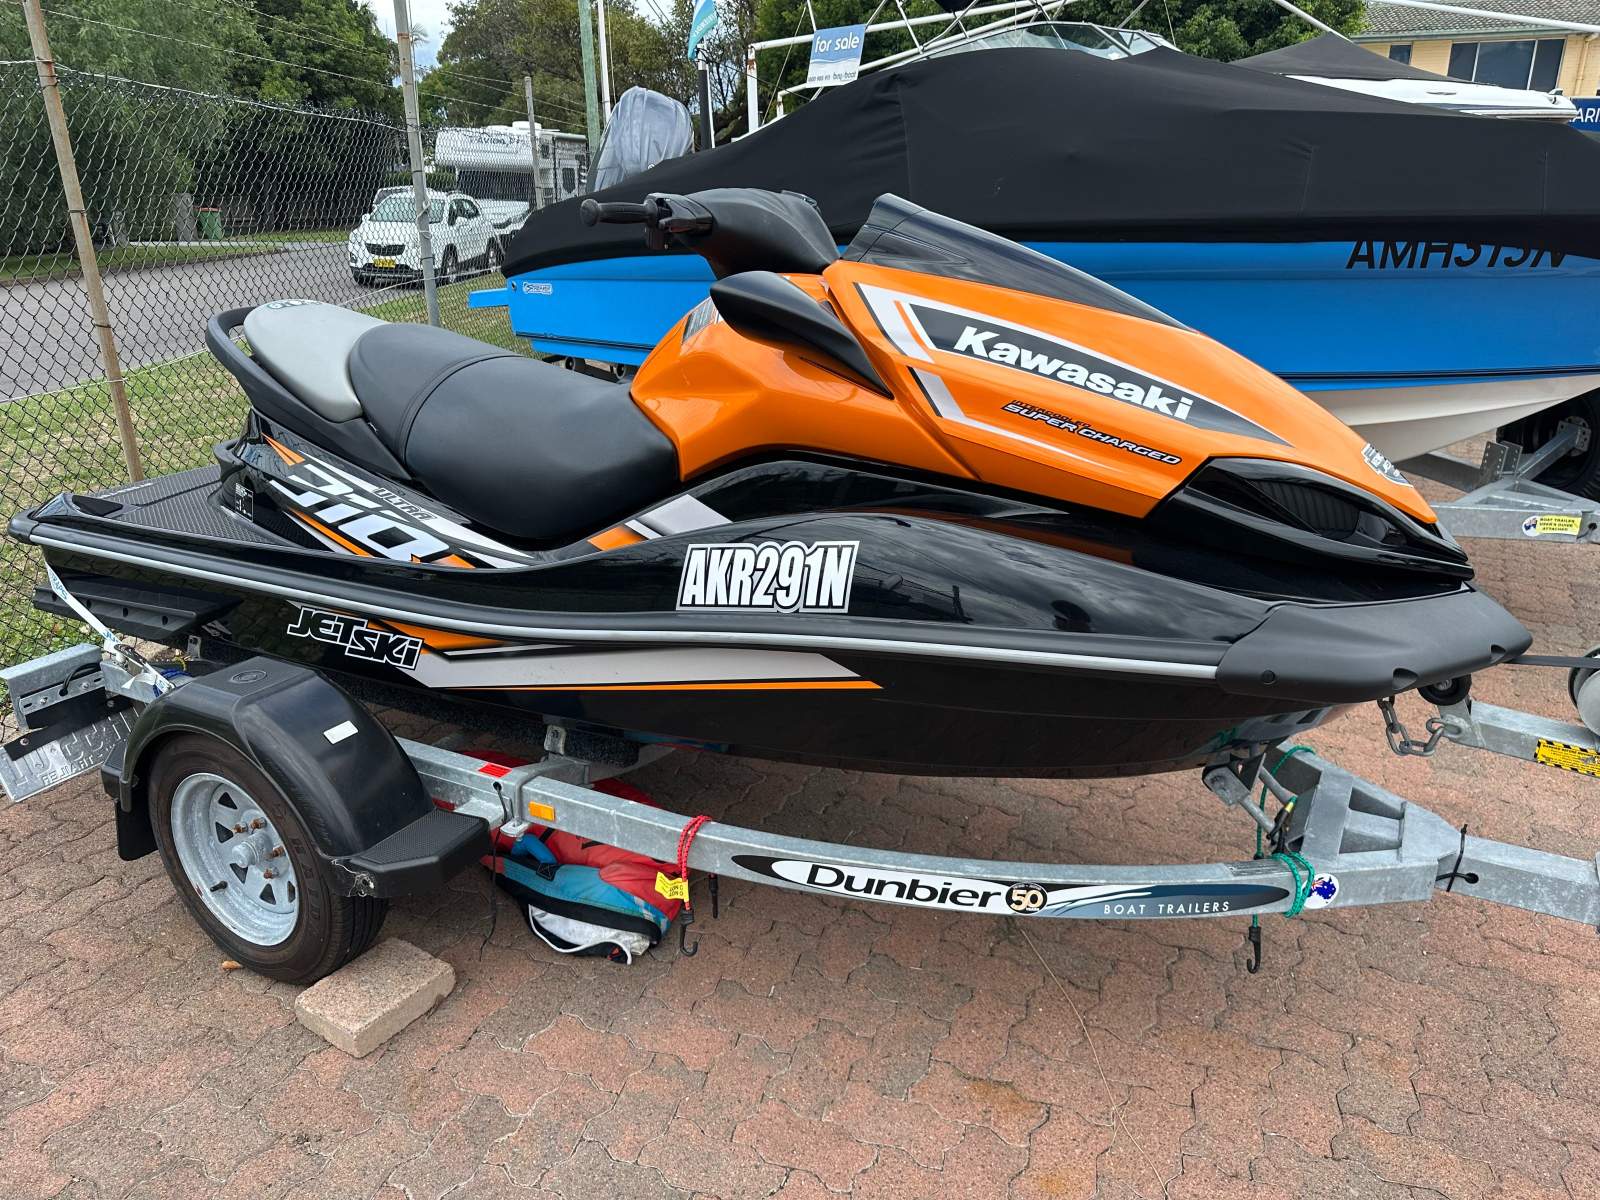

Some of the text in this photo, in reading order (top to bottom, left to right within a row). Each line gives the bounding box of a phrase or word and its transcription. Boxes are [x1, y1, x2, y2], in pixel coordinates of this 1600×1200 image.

[815, 32, 860, 53] for sale
[1569, 107, 1600, 123] ARI
[953, 325, 1195, 421] Kawasaki
[1001, 403, 1182, 465] SUPER CHARGED
[372, 488, 439, 520] ULTRA
[677, 542, 858, 612] AKR291N
[806, 863, 1001, 908] Dunbier
[1010, 889, 1044, 910] 50
[1103, 901, 1230, 915] BOAT TRAILERS
